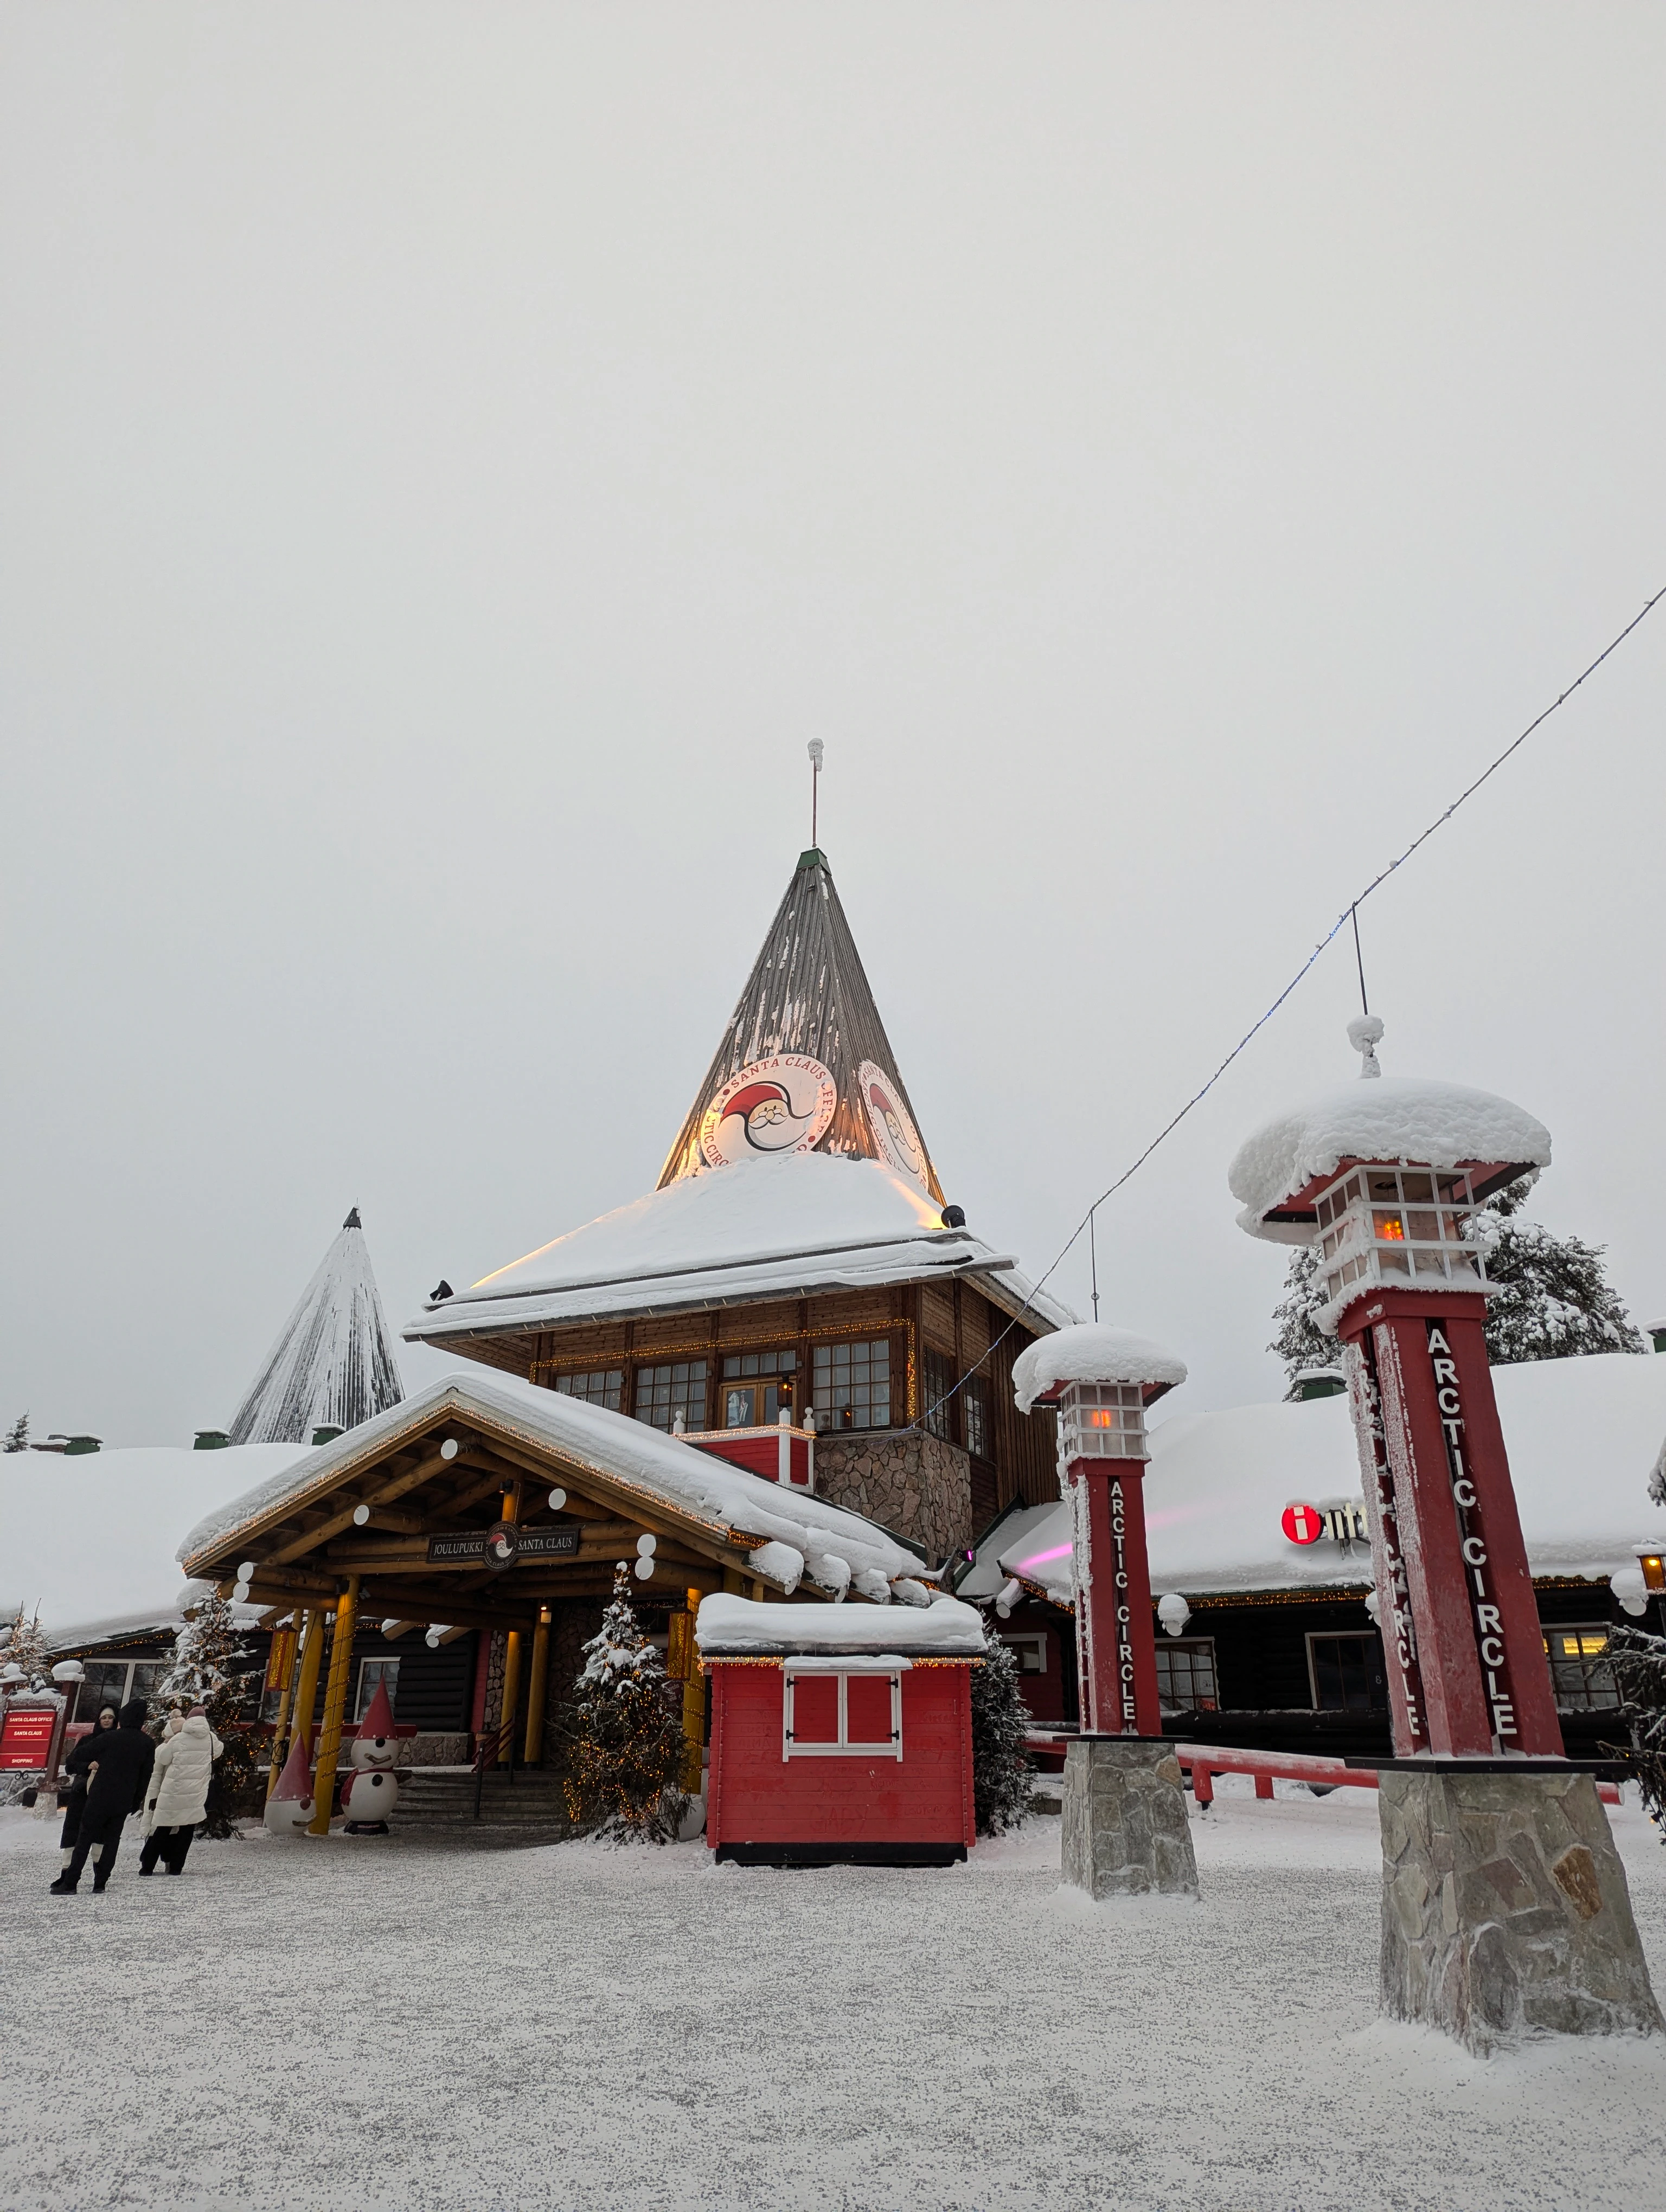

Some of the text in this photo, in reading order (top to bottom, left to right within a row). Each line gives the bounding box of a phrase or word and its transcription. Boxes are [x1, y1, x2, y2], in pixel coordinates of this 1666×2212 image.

[731, 1058, 779, 1088] SANTA
[785, 1057, 826, 1079] CLAUS
[864, 1064, 884, 1081] SANTA
[885, 1078, 909, 1120] CLAUS
[433, 1537, 573, 1556] JOULUPUKKI SANTA CLAUS
[1427, 1328, 1517, 1735] ARCTIC CIRCLE
[1110, 1481, 1136, 1720] ARCTIC CIRCLE
[1385, 1543, 1420, 1735] CIRCLE
